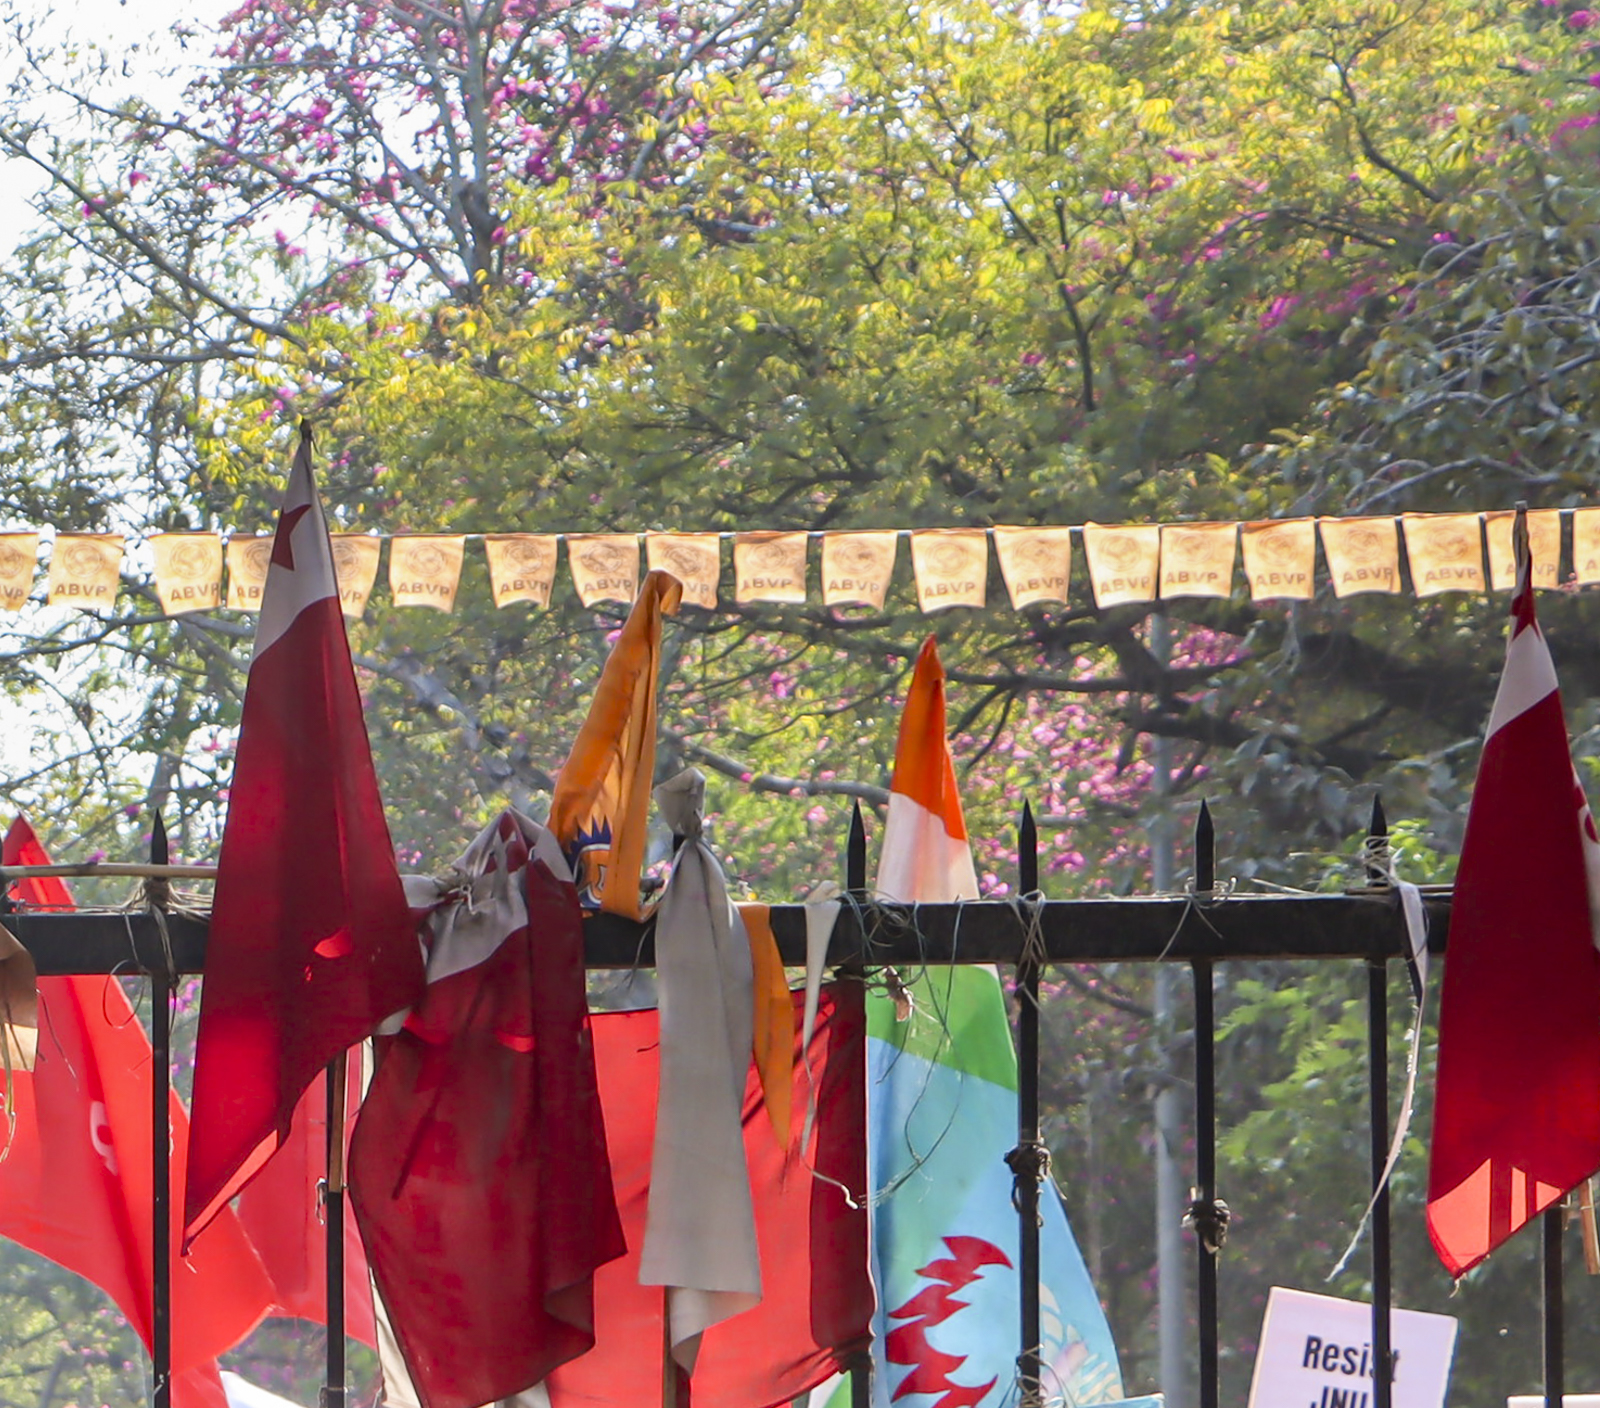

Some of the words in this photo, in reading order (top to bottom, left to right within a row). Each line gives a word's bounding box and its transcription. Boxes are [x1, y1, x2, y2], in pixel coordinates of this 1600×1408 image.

[1165, 571, 1219, 584] ABVP
[1255, 572, 1307, 586] ABVP
[1342, 566, 1393, 582] ABVP
[1424, 566, 1477, 581] ABVP
[54, 583, 108, 597] ABVP
[397, 582, 451, 598] ABVP
[829, 579, 879, 594] ABVP
[924, 582, 976, 599] ABVP
[1015, 577, 1064, 597] ABVP
[1100, 576, 1150, 595] ABVP
